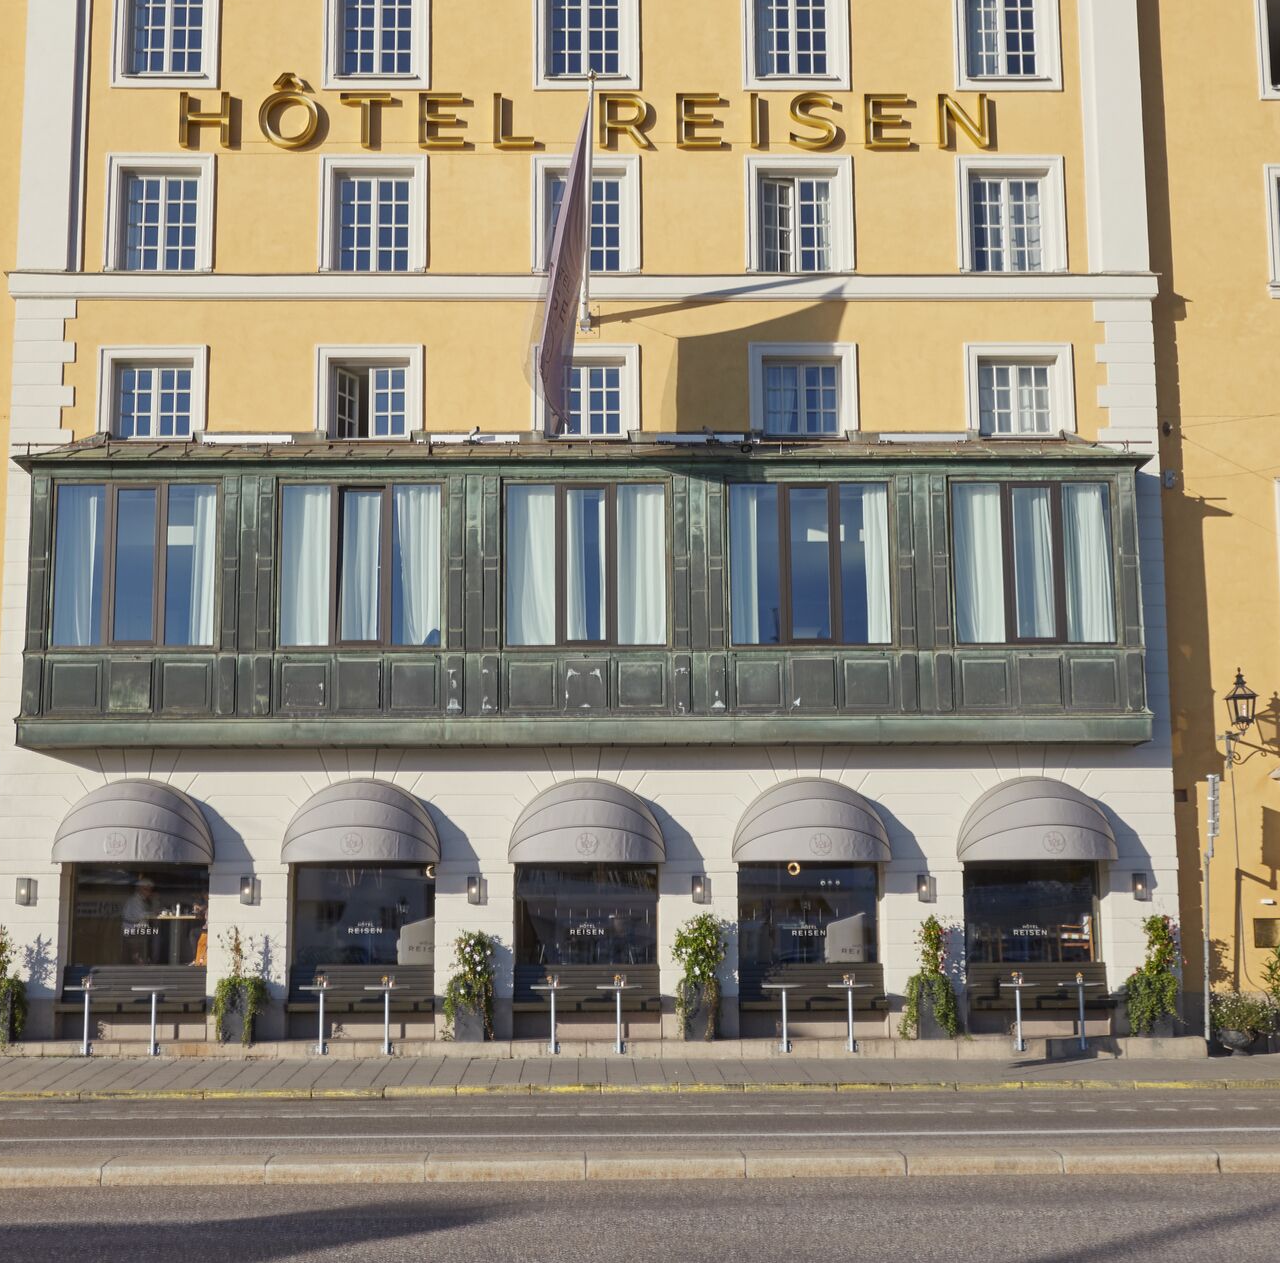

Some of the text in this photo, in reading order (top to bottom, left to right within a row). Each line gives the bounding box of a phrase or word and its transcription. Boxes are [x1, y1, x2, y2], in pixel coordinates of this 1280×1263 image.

[179, 72, 989, 150] HÔTEL REISEN
[123, 928, 159, 936] REISEN
[347, 927, 383, 935] REISEN
[791, 929, 826, 937] REISEN
